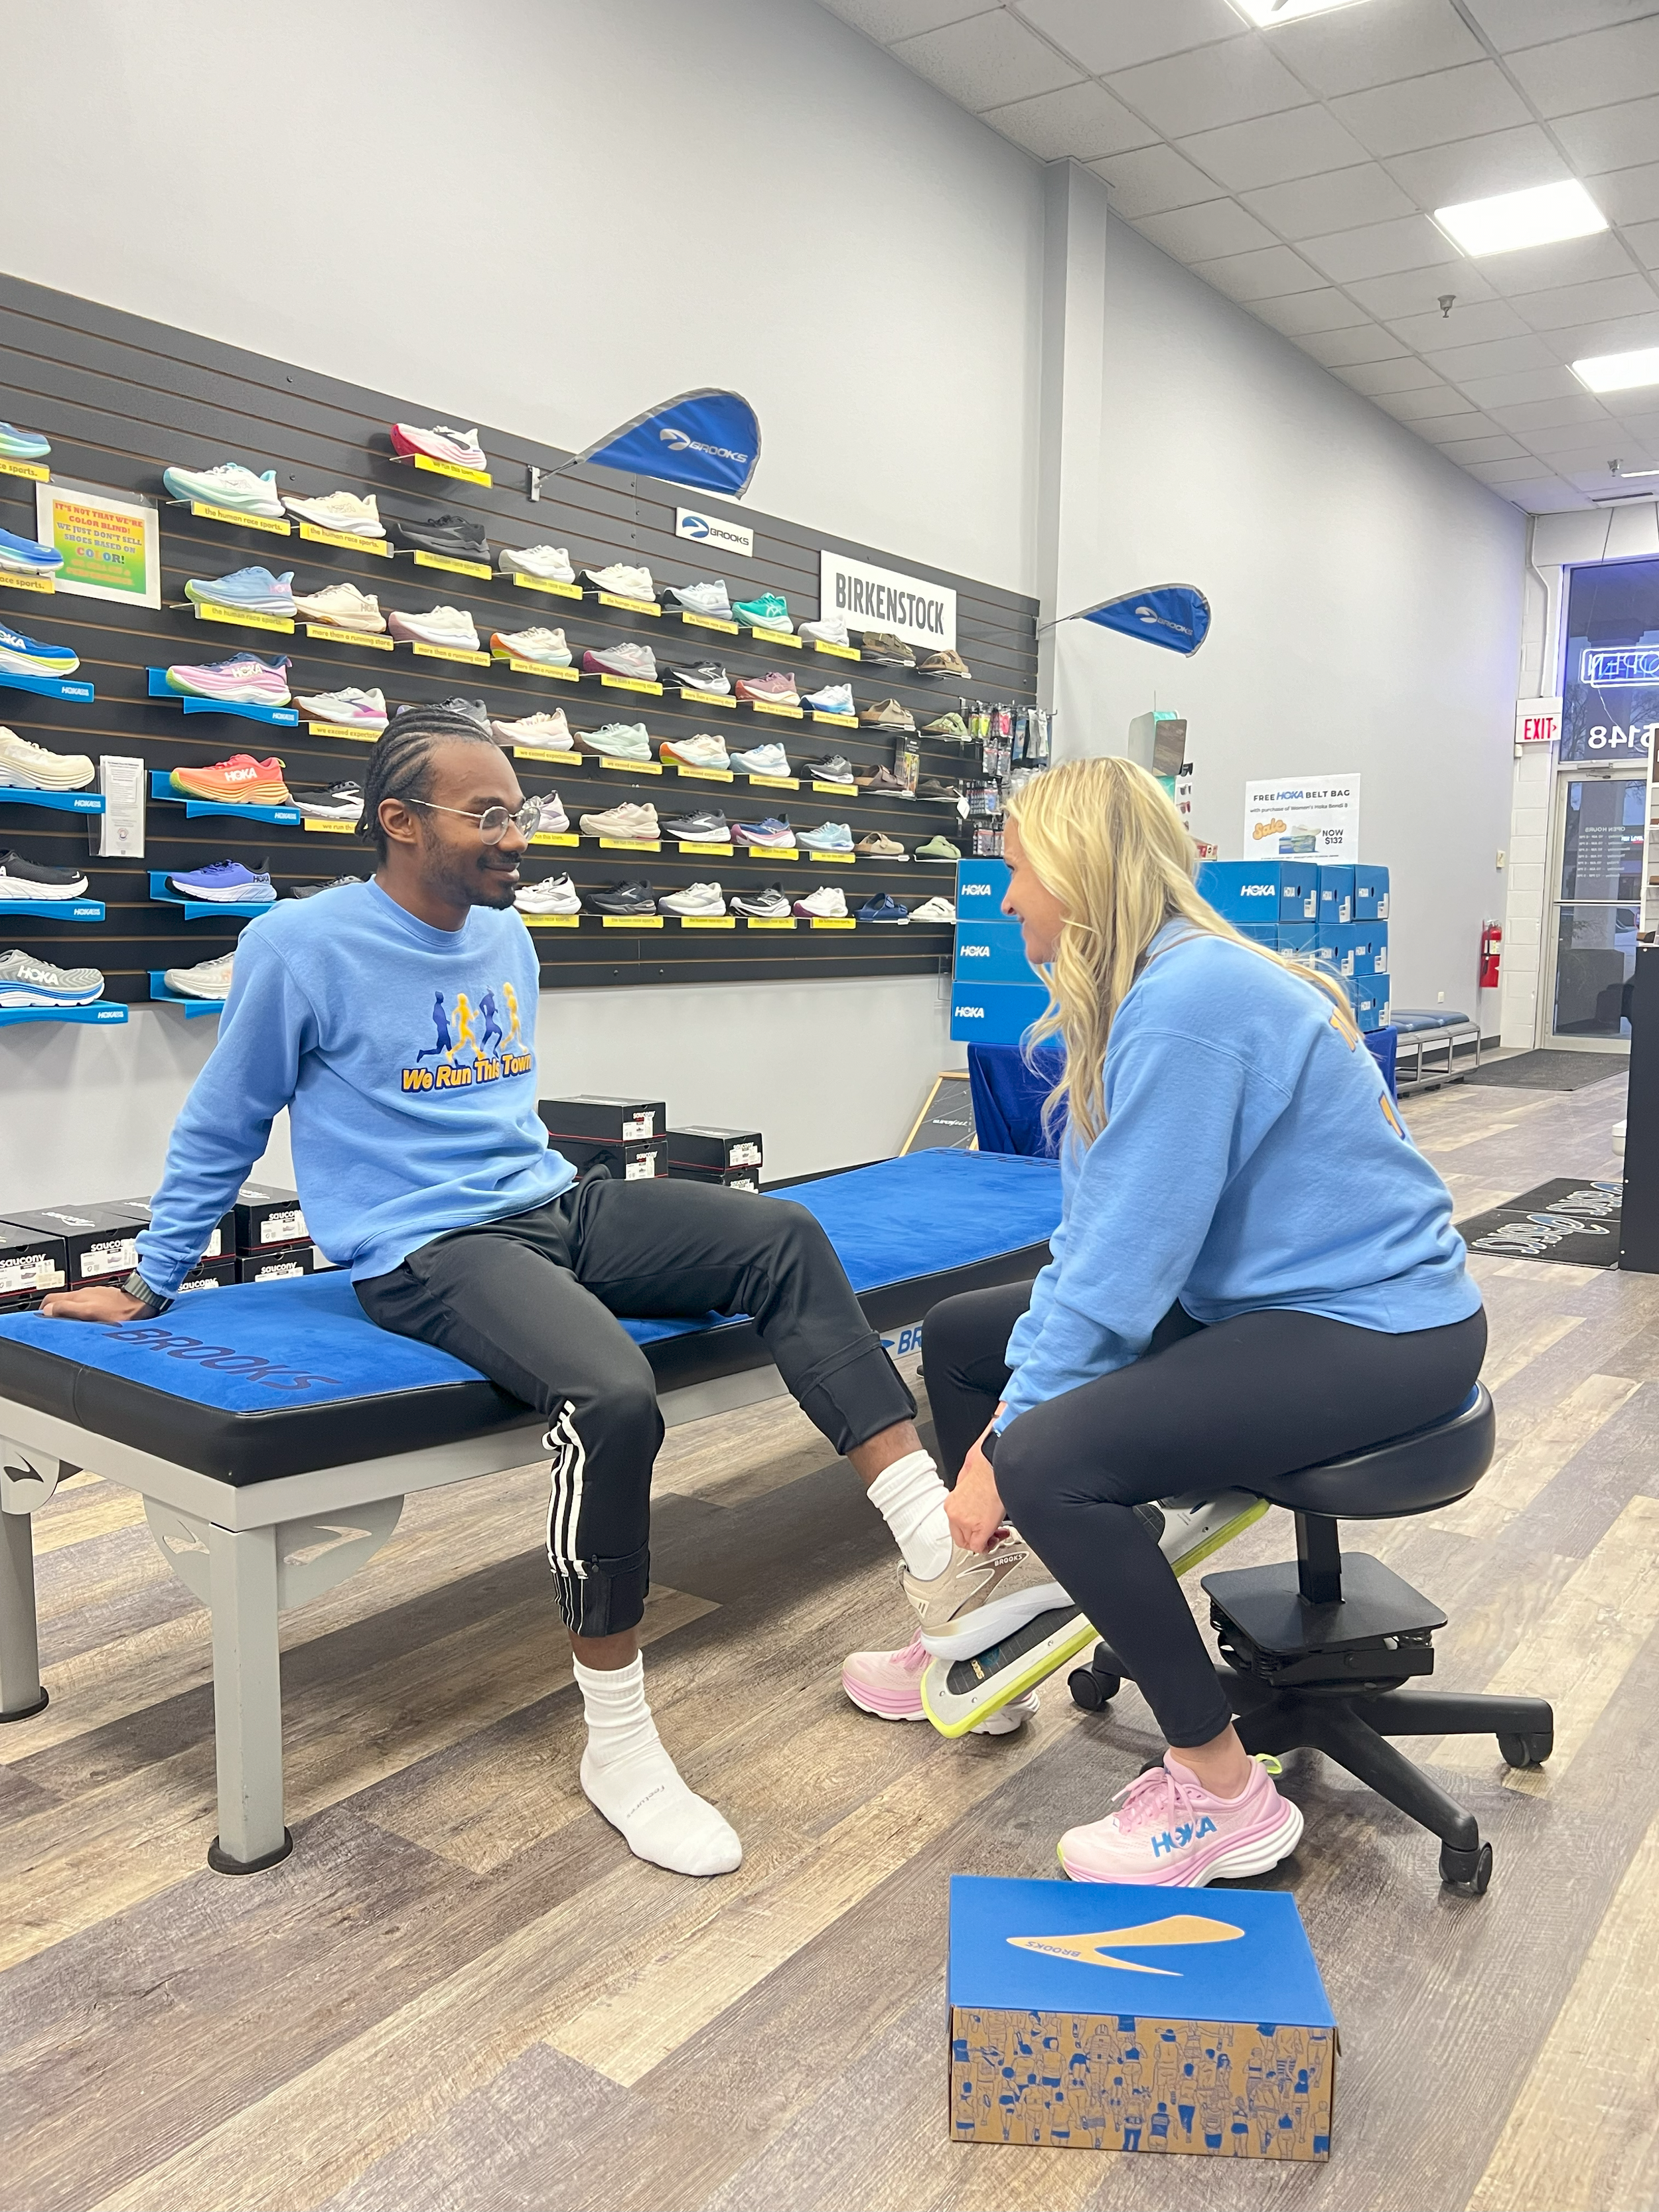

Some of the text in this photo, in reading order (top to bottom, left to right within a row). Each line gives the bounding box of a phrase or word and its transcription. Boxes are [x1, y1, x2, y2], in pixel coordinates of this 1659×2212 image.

[689, 441, 748, 463] BROOKS
[9, 465, 38, 476] sports.
[55, 502, 143, 528] IT'S NOT THAT WE'RE
[205, 507, 283, 531] the human race sports.
[69, 516, 131, 534] COLOR BLIND!
[57, 522, 142, 546] WE JUST DON'T SELL
[64, 534, 92, 544] SHOES
[94, 540, 121, 550] BASED
[322, 530, 342, 540] human
[359, 538, 379, 549] sports.
[710, 528, 749, 545] BROOKS
[16, 579, 44, 589] sports.
[836, 572, 944, 635] BIRKENSTOCK
[1157, 617, 1193, 636] BROOKS
[0, 631, 27, 650] OKA
[232, 664, 263, 678] HOKA
[1524, 717, 1553, 740] EXIT
[225, 767, 257, 782] HOKA
[1276, 790, 1304, 800] HOKA
[1253, 818, 1287, 840] Sale
[962, 885, 991, 895] HOKA
[1240, 885, 1275, 897] HOKA
[960, 946, 990, 957] HOKA
[17, 965, 59, 985] HOKA
[955, 1006, 984, 1018] HOKA
[402, 1053, 531, 1090] We Run This Town
[91, 1239, 123, 1252] sauco
[261, 1262, 297, 1274] saucony
[102, 1328, 343, 1390] BROOKS
[995, 1554, 1023, 1566] BROOKS
[1151, 1816, 1217, 1858] HOKA
[1025, 1941, 1082, 1957] BROOKS
